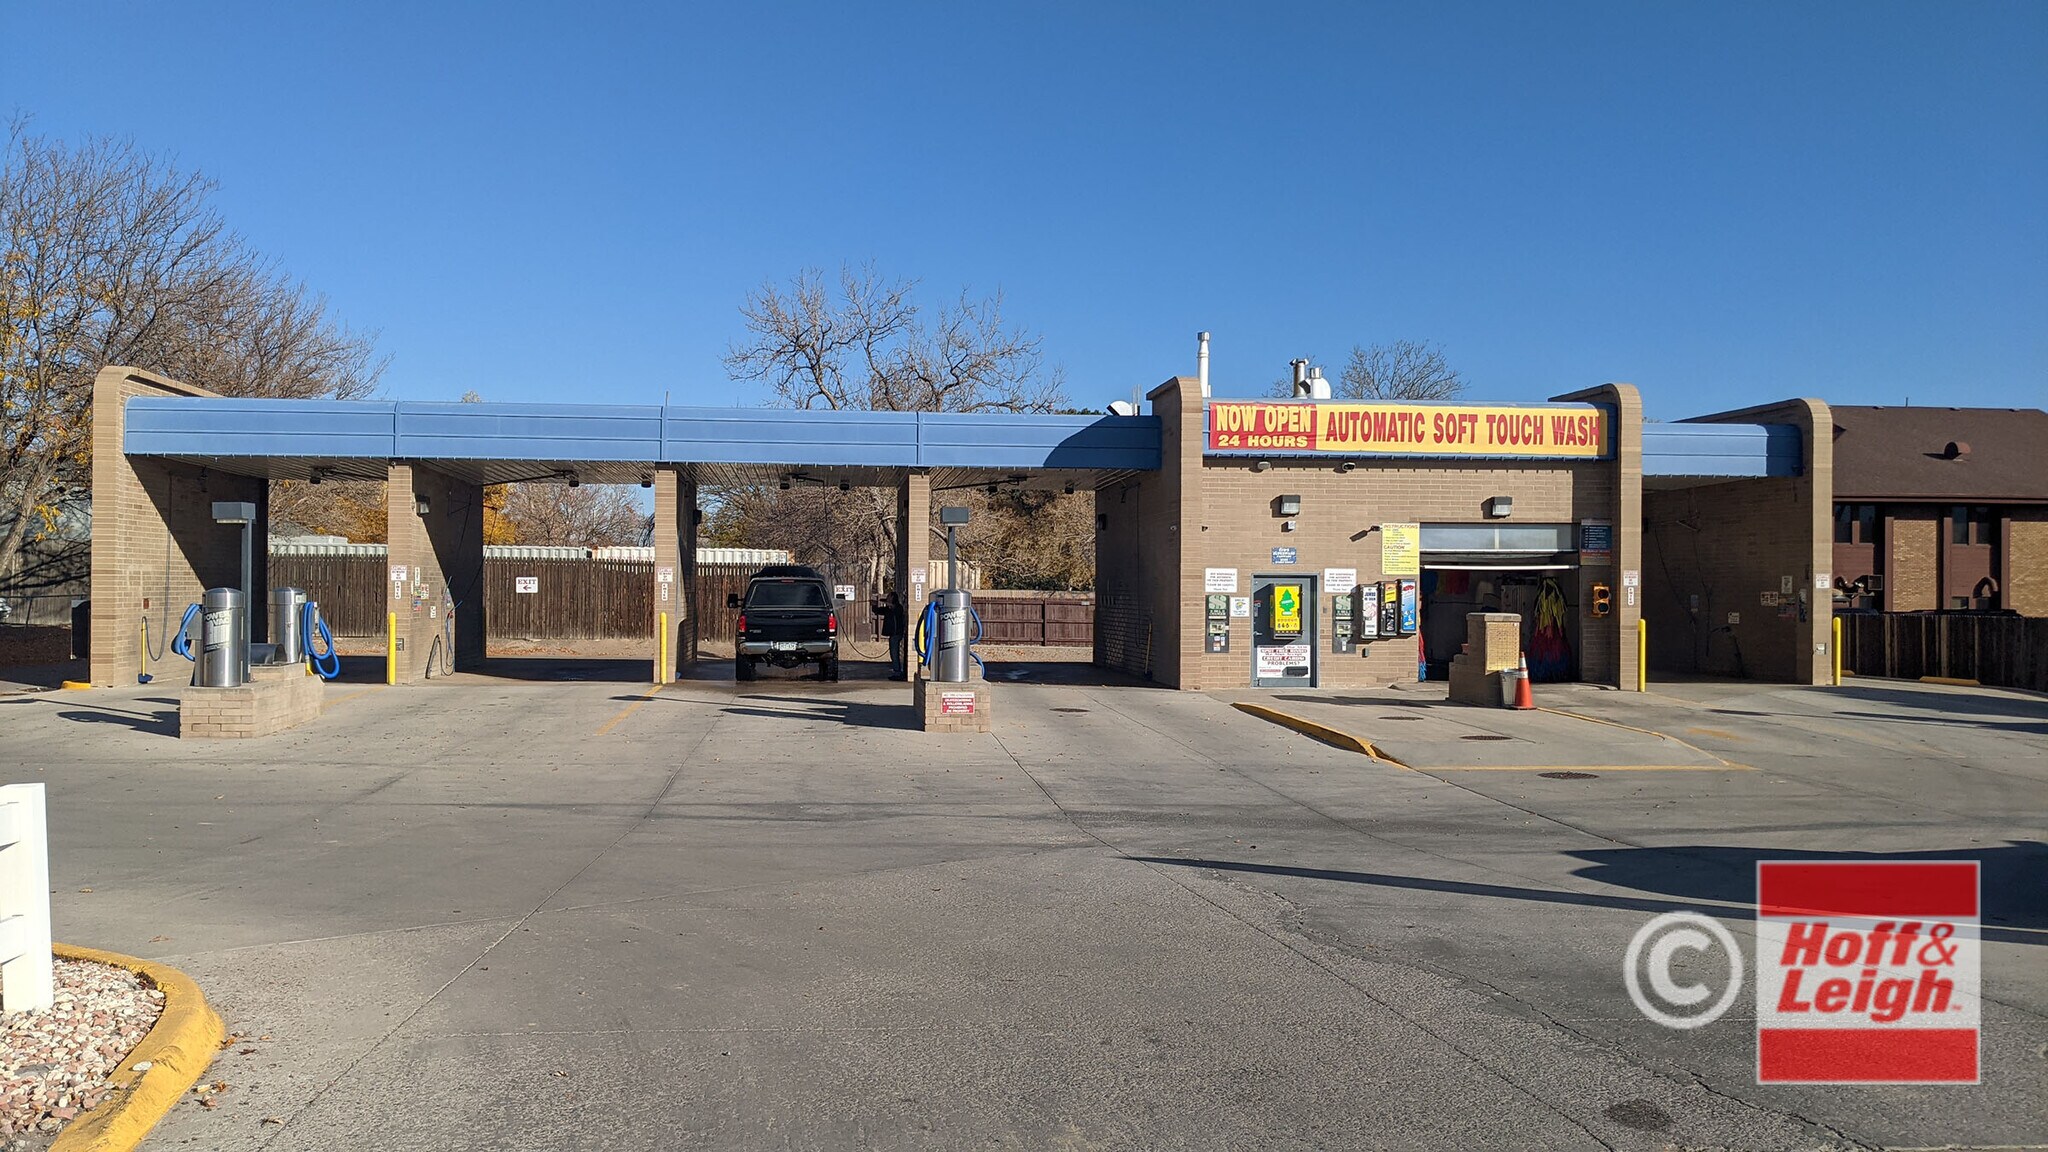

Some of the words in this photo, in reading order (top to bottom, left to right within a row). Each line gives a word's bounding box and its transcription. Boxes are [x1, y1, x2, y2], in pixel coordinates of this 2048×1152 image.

[1216, 405, 1257, 432] NOW
[1264, 406, 1311, 433] OPEN
[1325, 411, 1426, 444] AUTOMATIC
[1433, 412, 1478, 444] SOFT
[1486, 413, 1544, 446] TOUCH
[1551, 415, 1600, 447] WASH
[1218, 435, 1240, 447] 24
[1247, 435, 1308, 448] HOURS
